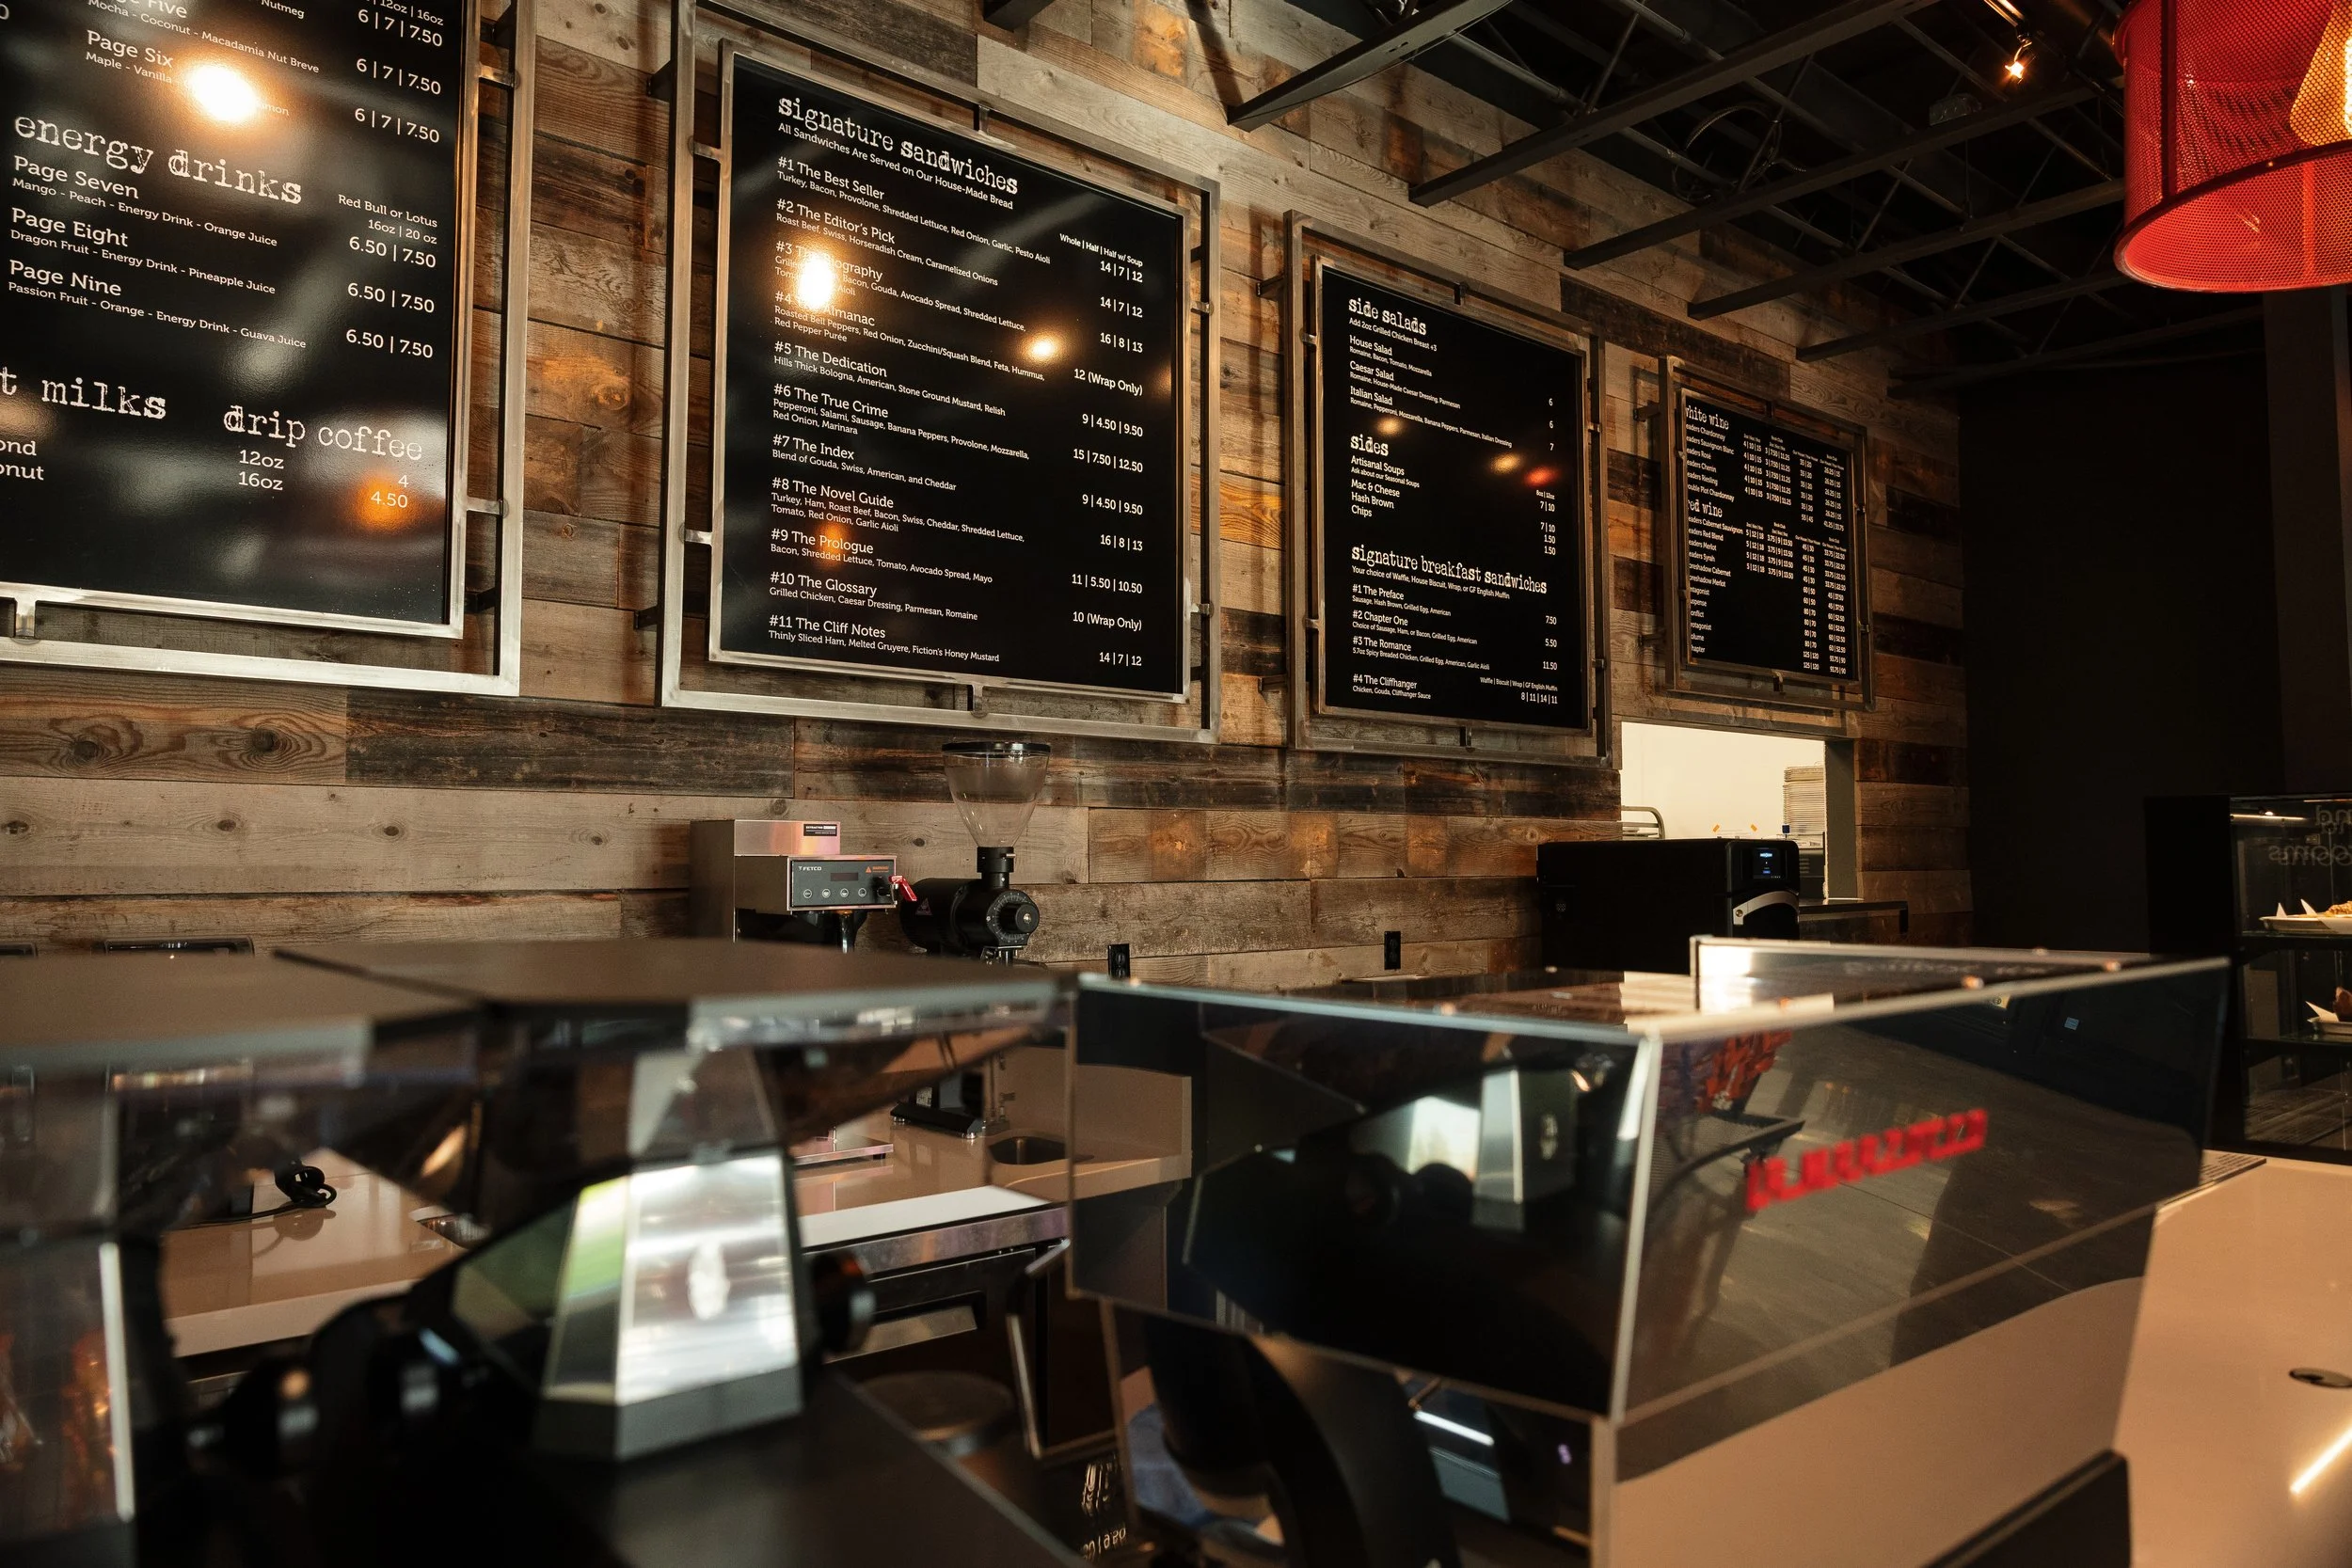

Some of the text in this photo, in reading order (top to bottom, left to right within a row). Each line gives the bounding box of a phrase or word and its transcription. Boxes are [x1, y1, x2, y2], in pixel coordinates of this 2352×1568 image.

[262, 0, 305, 19] Nutmeg
[87, 29, 173, 69] Page Six
[86, 52, 121, 70] Maple
[134, 64, 172, 84] Vanilla
[355, 108, 365, 121] 6
[381, 115, 391, 128] 7
[406, 122, 439, 143] 7.50
[778, 98, 1018, 195] signature sandwiches
[15, 117, 302, 204] energy drinks
[778, 122, 1013, 210] All Sandwiches Are Served on Our House-Made Bread
[14, 155, 138, 199] Page Seven
[778, 156, 884, 199] #1 The Best Seller
[12, 178, 56, 196] Mango
[70, 191, 105, 207] Peach
[119, 202, 159, 220] Energy
[162, 212, 193, 228] Drink
[204, 222, 246, 239] Orange
[248, 232, 278, 246] Juice
[339, 194, 437, 228] Red Bull or Lotus
[776, 198, 895, 245] #2 The Editor's Pick
[12, 207, 128, 247] Page Eight
[349, 236, 387, 256] 6.50
[403, 248, 436, 268] 7.50
[9, 260, 121, 296] Page Nine
[1348, 297, 1426, 336] side salads
[346, 329, 384, 348] 6.50
[400, 339, 433, 358] 7.50
[1349, 334, 1392, 356] House Salad
[774, 341, 887, 377] #5 The Dedication
[1349, 360, 1394, 381] Caesar Salad
[1074, 368, 1142, 396] 12 (Wrap Only)
[1350, 386, 1392, 405] Italian Salad
[41, 377, 166, 420] milks
[773, 383, 888, 418] #6 The True Crime
[1549, 398, 1553, 406] 6
[223, 404, 422, 461] drip coffee
[1708, 414, 1729, 430] wine
[772, 434, 854, 460] #7 The Index
[1350, 434, 1389, 456] sides
[239, 450, 284, 469] 12oz
[1351, 455, 1405, 476] Artisanal Soups
[239, 471, 283, 491] 16oz
[398, 475, 409, 488] 4
[771, 477, 894, 508] #8 The Novel Guide
[1351, 479, 1400, 498] Mac & Cheese
[371, 490, 408, 509] 4.50
[1351, 491, 1394, 509] Hash Brown
[1351, 504, 1373, 517] Chips
[1702, 502, 1723, 517] wine
[771, 528, 874, 555] #9 The Prologue
[1352, 544, 1547, 594] signature breakfast sandwiches
[771, 571, 877, 598] #10 The Glossary
[1352, 584, 1404, 600] #1 The Preface
[770, 587, 798, 598] Grilled
[838, 595, 866, 606] Caesar
[946, 609, 977, 621] Romaine
[769, 614, 885, 639] #11 The Cliff Notes
[1073, 611, 1142, 632] 10 (Wrap Only)
[1353, 610, 1408, 626] #2 Chapter One
[768, 630, 796, 642] Thinly
[798, 633, 823, 643] Sliced
[849, 639, 876, 649] Melted
[945, 649, 969, 660] Honey
[970, 652, 999, 662] Mustard
[1353, 636, 1411, 652] #3 The Romance
[1545, 638, 1557, 648] 5.50
[1353, 673, 1417, 690] #4 The Cliffhanger
